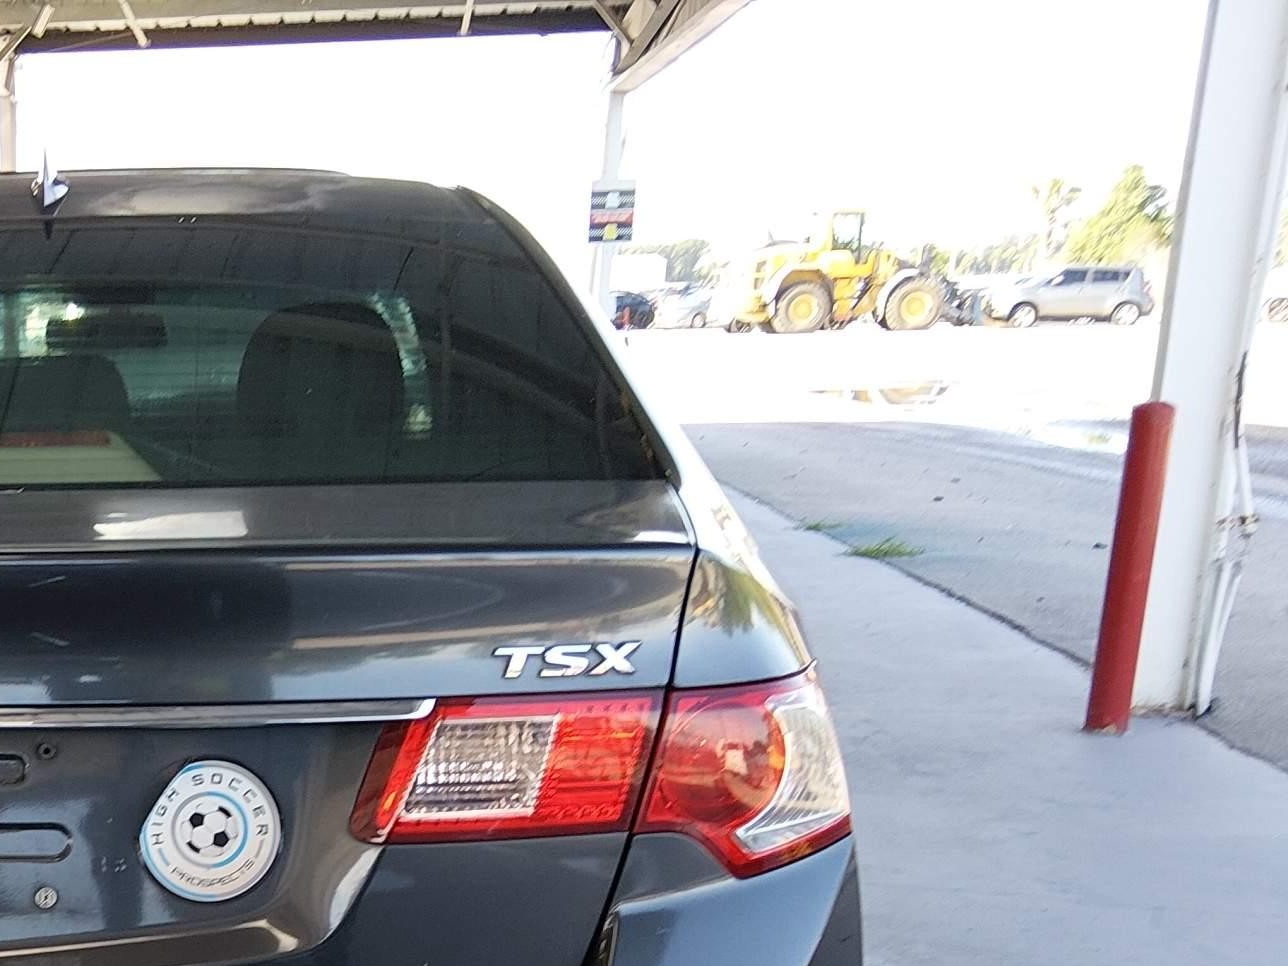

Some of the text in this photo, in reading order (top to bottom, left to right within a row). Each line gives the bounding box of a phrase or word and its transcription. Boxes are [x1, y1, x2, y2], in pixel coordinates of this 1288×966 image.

[492, 639, 643, 679] TSX
[151, 772, 270, 847] HIGH SOCCER
